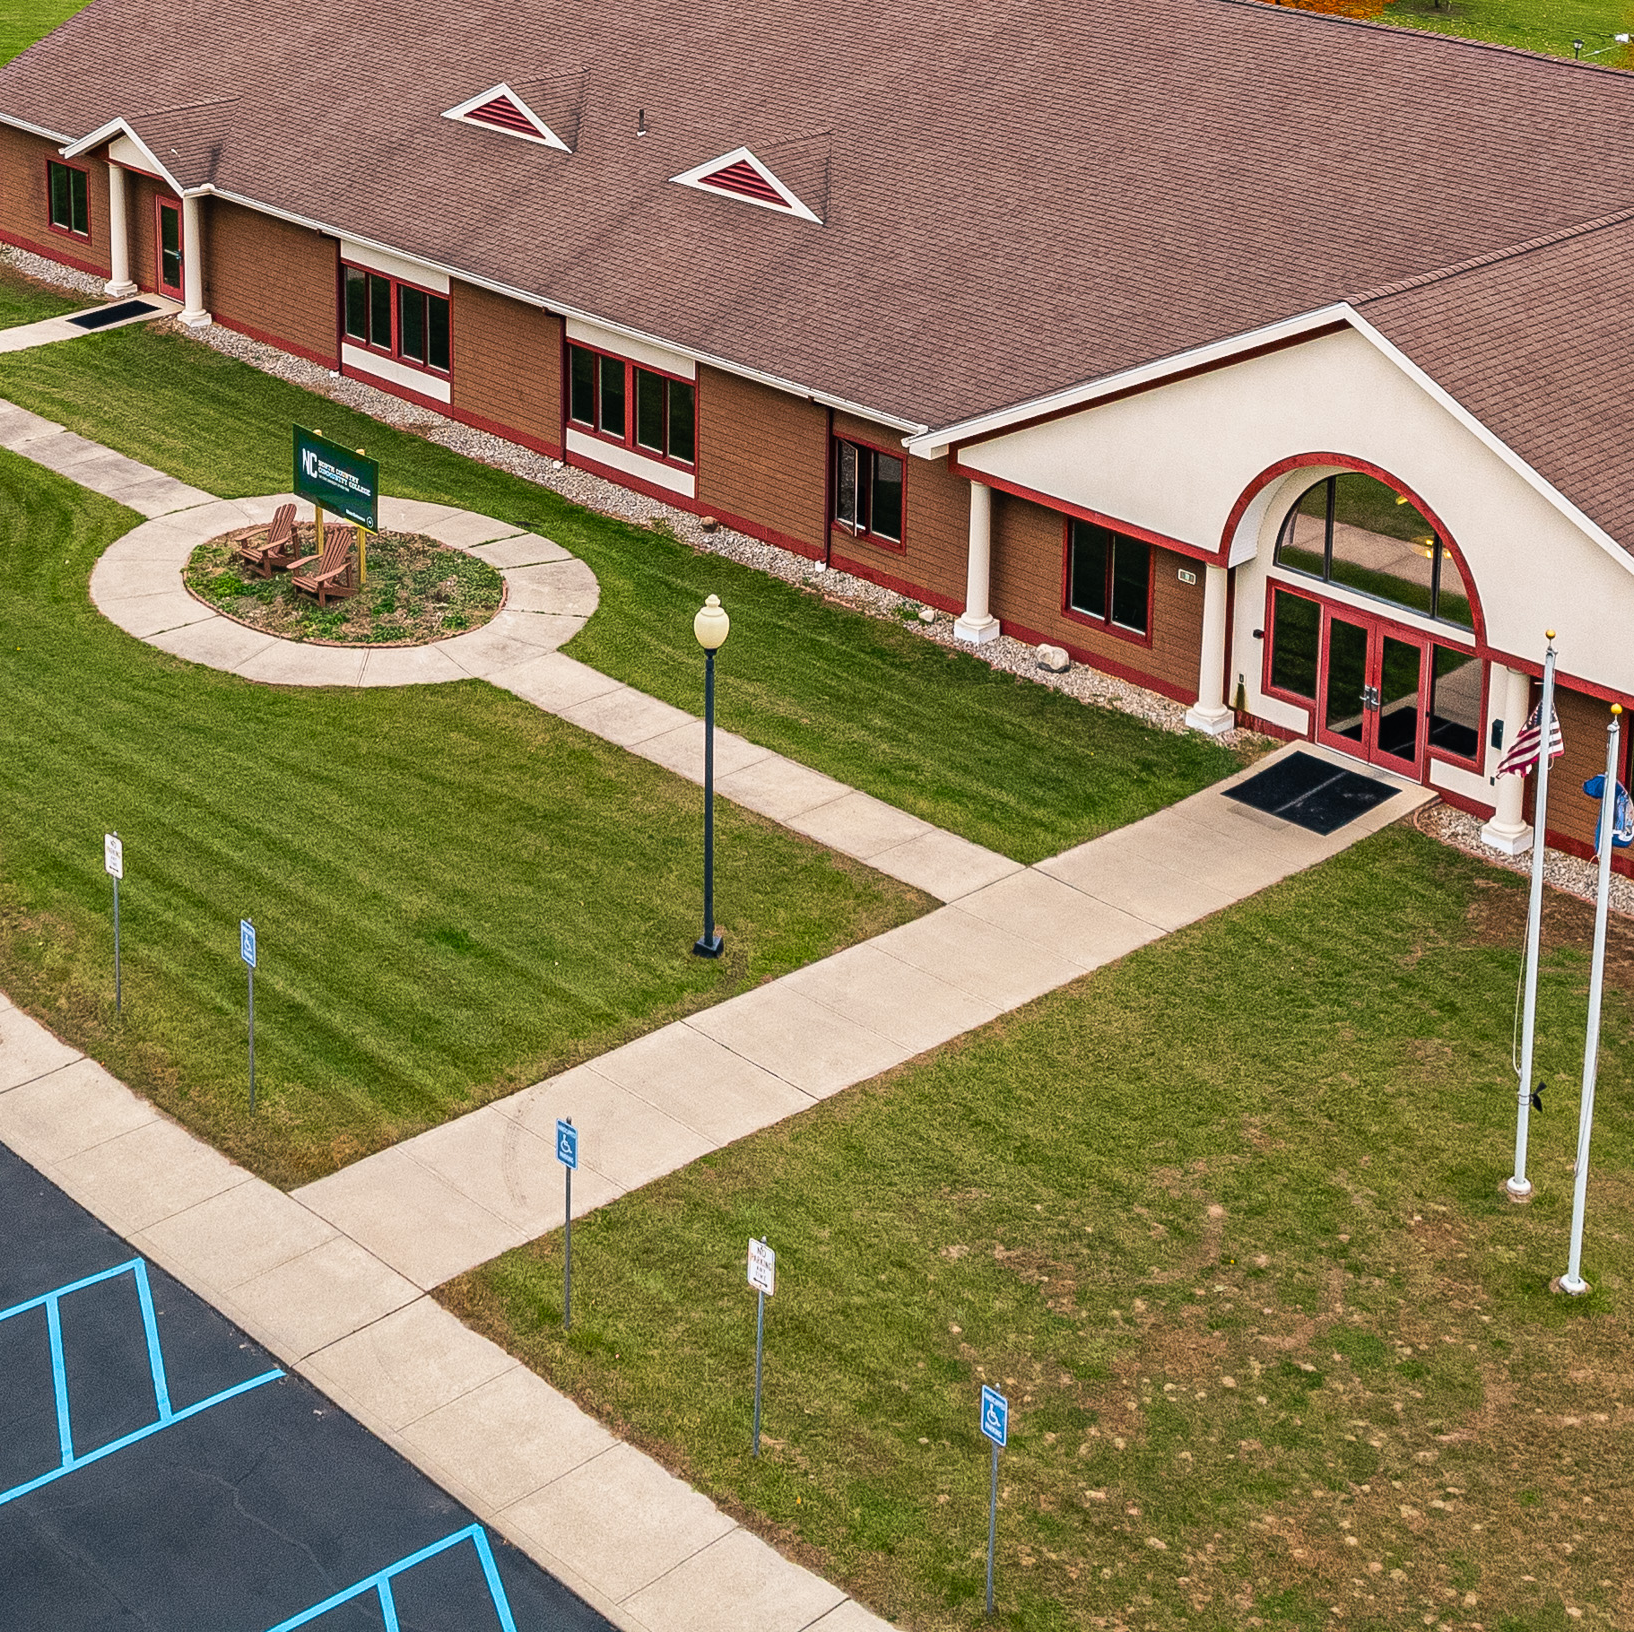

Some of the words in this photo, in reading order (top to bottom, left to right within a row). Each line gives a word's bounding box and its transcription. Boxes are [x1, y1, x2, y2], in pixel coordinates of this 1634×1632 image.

[302, 447, 318, 479] NC
[318, 459, 335, 473] NORTH
[335, 468, 359, 484] COUNTRY
[318, 466, 348, 486] COMMUNITY
[348, 481, 371, 497] COLLEGE
[751, 1254, 772, 1272] PARKING
[757, 1247, 767, 1258] NO
